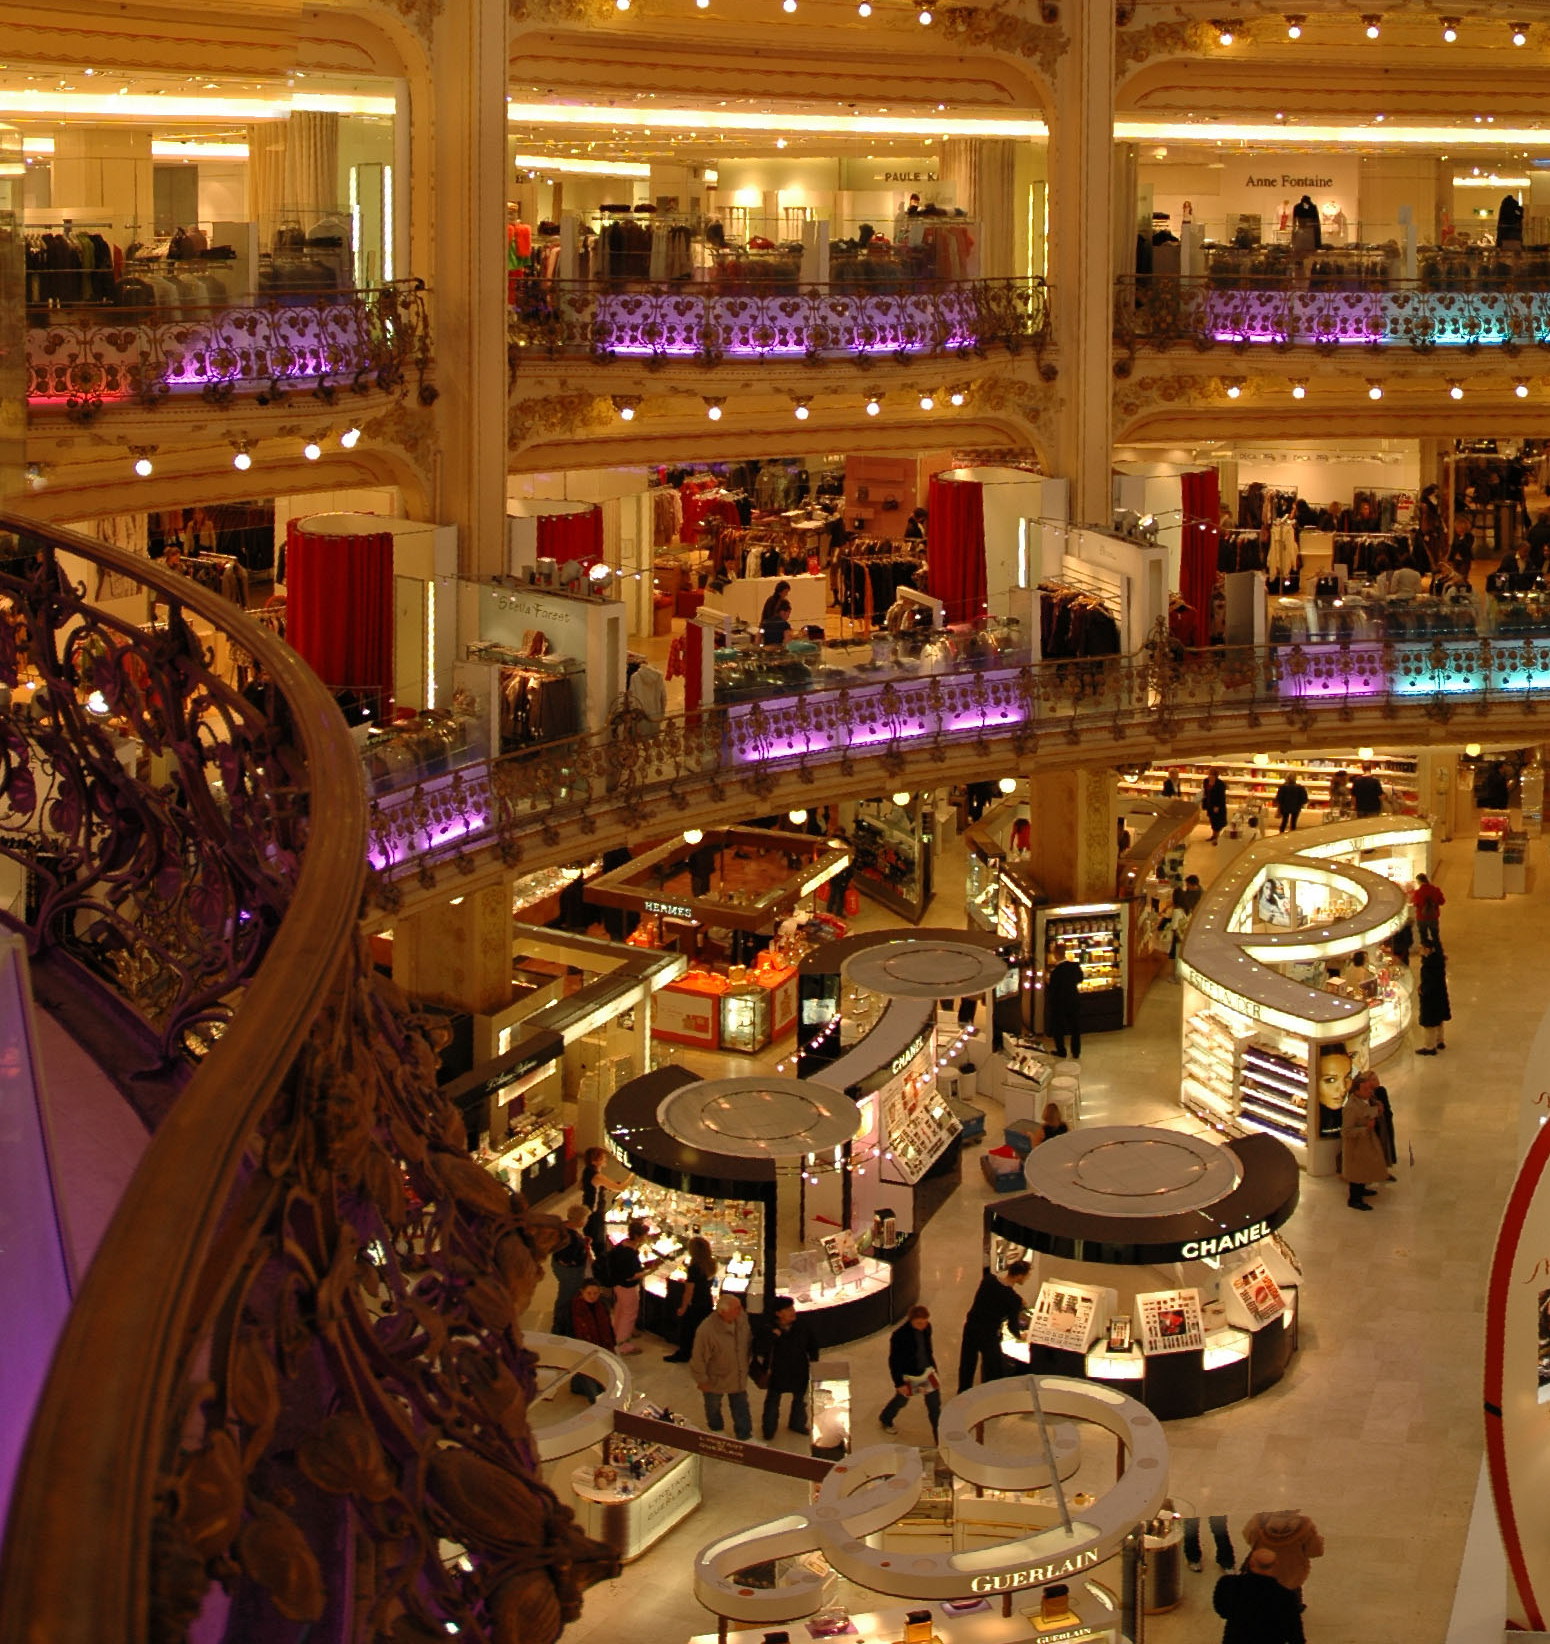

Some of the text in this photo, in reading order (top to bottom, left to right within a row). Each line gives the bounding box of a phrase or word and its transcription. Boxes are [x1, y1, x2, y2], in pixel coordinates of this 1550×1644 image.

[884, 172, 940, 182] PAULE K
[1246, 174, 1334, 188] Anne Fontaine
[1182, 1221, 1271, 1259] CHANEL
[970, 1547, 1098, 1593] GUERLAIN
[1036, 1627, 1092, 1644] GUERLAIN
